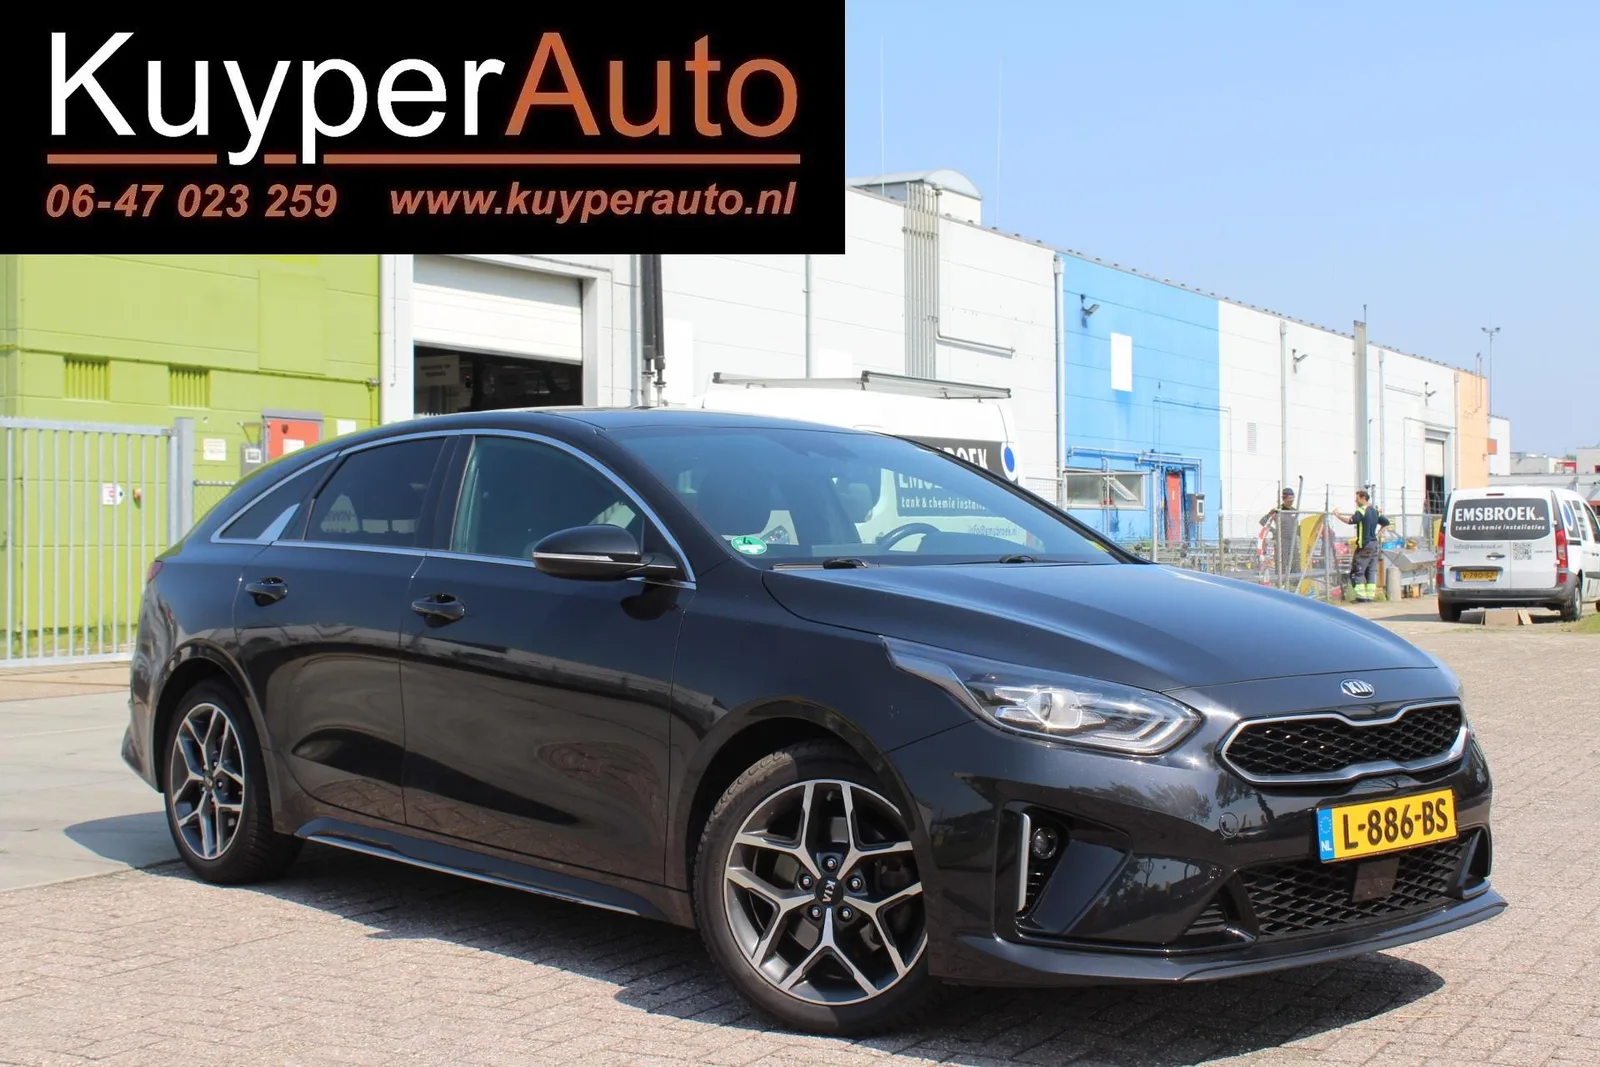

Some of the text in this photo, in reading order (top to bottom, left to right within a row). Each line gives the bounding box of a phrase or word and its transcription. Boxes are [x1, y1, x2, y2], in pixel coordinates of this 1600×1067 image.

[901, 496, 920, 508] tank
[1343, 681, 1373, 694] KIA
[1343, 797, 1449, 850] L-886-BS
[1320, 840, 1333, 851] NL
[822, 880, 836, 902] KIA
